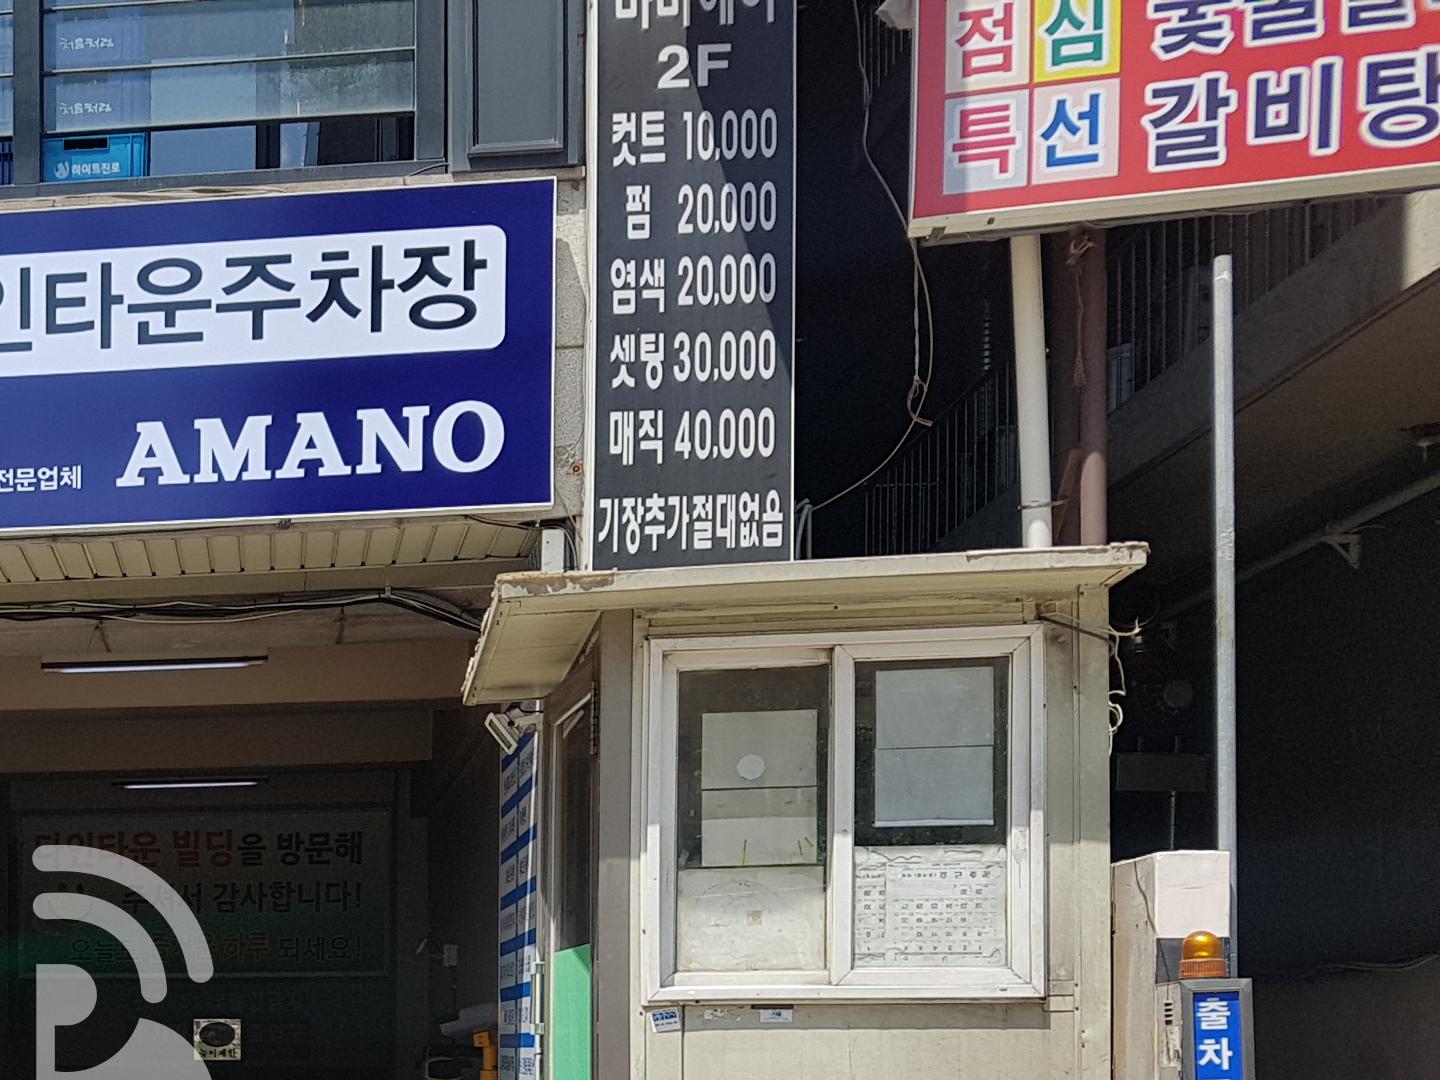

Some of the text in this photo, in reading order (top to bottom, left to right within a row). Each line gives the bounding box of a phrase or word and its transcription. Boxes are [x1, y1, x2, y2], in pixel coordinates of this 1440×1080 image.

[657, 43, 732, 89] 2F
[958, 0, 1105, 78] 점심
[612, 108, 777, 168] 컷트 10,000
[951, 92, 1102, 175] 특선
[1147, 49, 1440, 169] 갈비탕
[71, 161, 121, 176] 하이트진로
[626, 180, 777, 240] 펌 20,000
[610, 252, 776, 315] 염색 20,000
[610, 329, 776, 390] 셋팅 30,000
[115, 400, 505, 488] AMANO
[609, 407, 776, 466] 매직 40,000
[598, 489, 784, 555] 기장추가절대없음
[171, 829, 266, 868] 빌딩을
